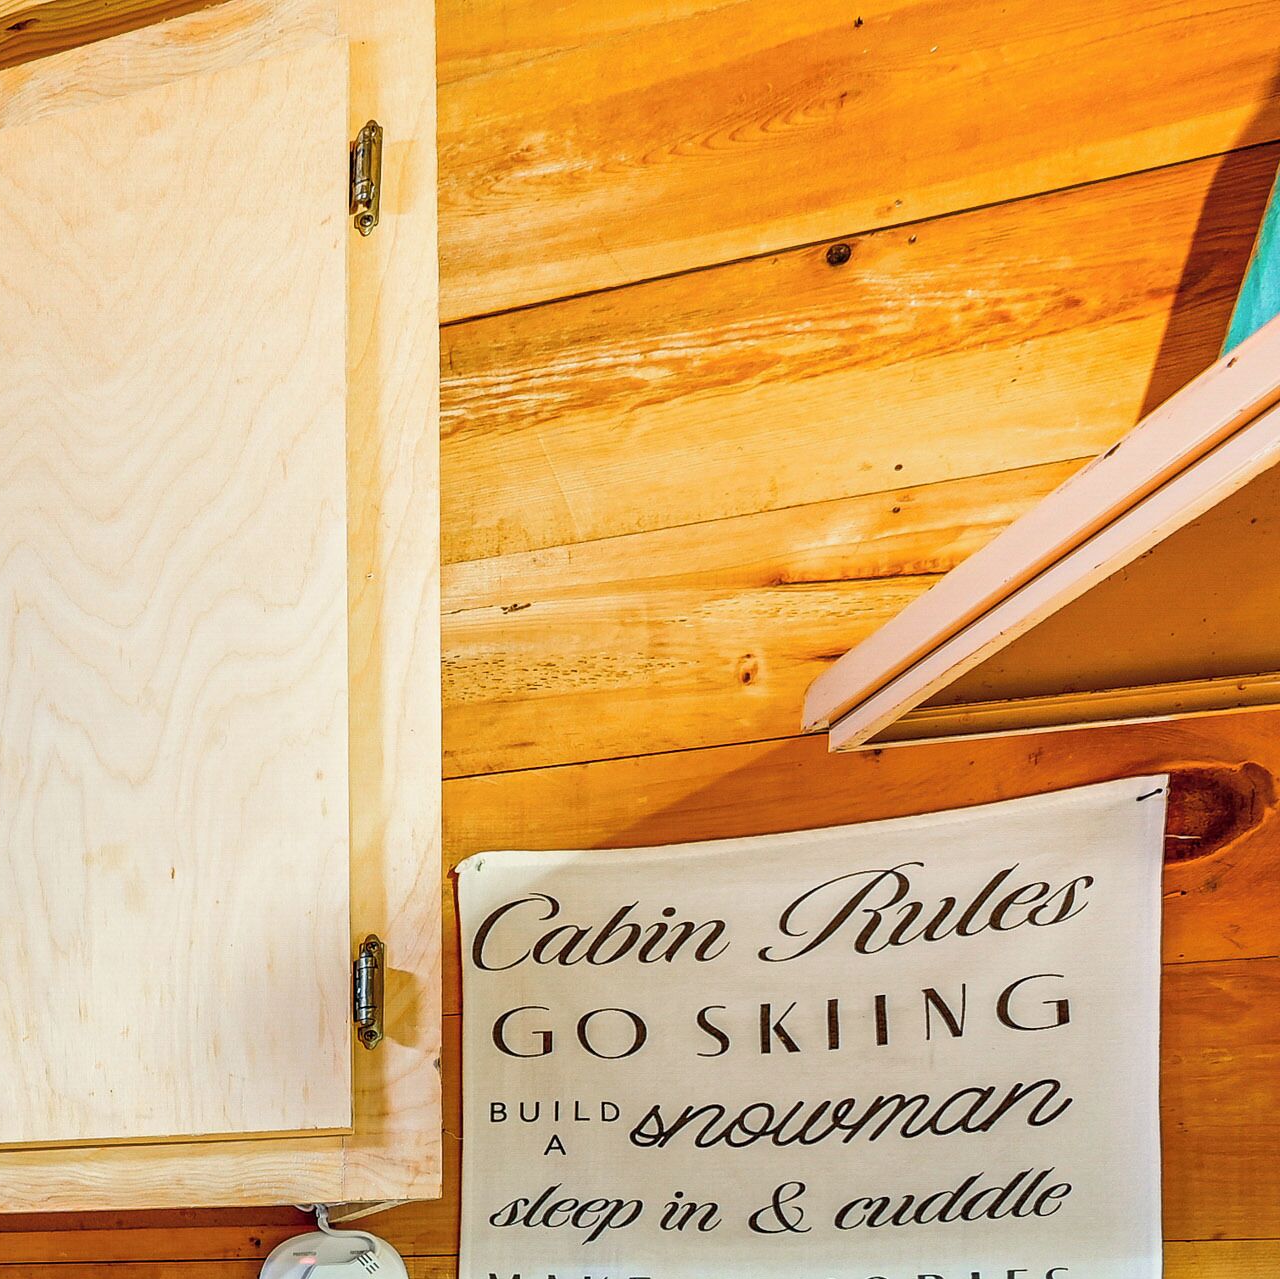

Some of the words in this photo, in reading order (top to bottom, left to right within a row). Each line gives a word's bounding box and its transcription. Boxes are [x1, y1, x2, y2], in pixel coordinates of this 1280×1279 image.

[472, 892, 730, 972] Cabin
[758, 861, 1095, 962] Rules
[491, 1005, 648, 1059] GO
[697, 973, 1072, 1058] SKIING
[489, 1100, 622, 1124] BUILD
[543, 1134, 567, 1156] A
[629, 1077, 1073, 1149] snowman
[488, 1182, 642, 1245] sleep
[659, 1190, 723, 1233] in
[749, 1180, 813, 1235] &
[834, 1166, 1073, 1230] cuddle
